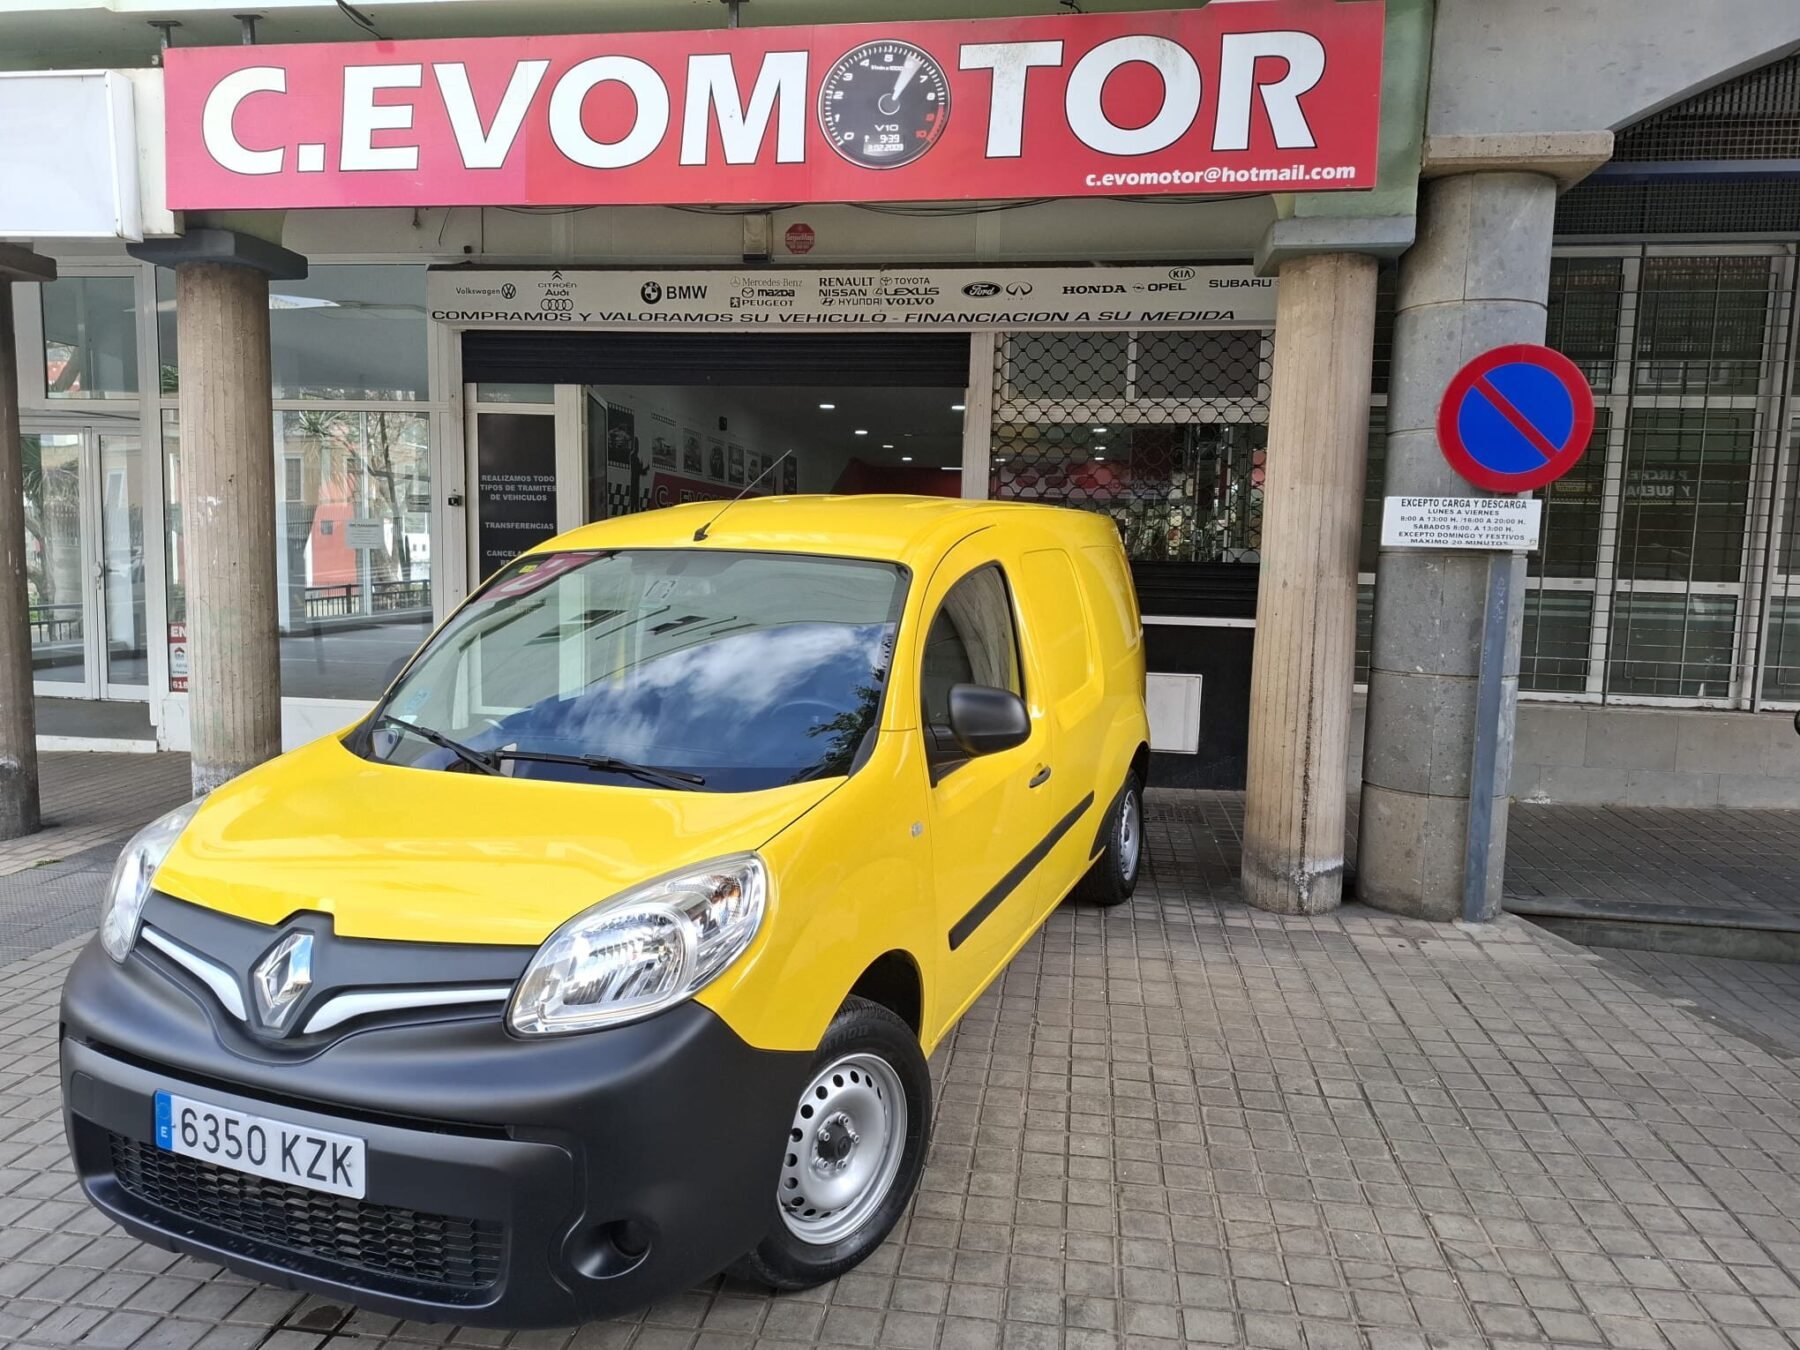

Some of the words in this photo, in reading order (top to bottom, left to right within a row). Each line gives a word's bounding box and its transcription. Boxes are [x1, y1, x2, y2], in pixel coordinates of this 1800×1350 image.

[842, 72, 854, 81] 3
[919, 75, 929, 83] 7
[833, 90, 845, 100] 2
[834, 113, 841, 122] 1
[874, 124, 899, 132] V10
[1085, 164, 1356, 187] c.evomotor@hotmail.com
[818, 276, 875, 287] RENAULT
[894, 277, 931, 285] TOYOTA
[1208, 279, 1272, 288] SUBARU
[455, 287, 501, 296] Volkswagen
[883, 287, 940, 296] LEXUS
[967, 282, 997, 297] Ford
[1061, 284, 1127, 295] HONDA
[1147, 282, 1187, 292] OPEL
[544, 288, 570, 297] Audi
[666, 285, 708, 300] BMW
[818, 288, 868, 297] NISSAN
[741, 299, 794, 307] PEUGEOT
[838, 297, 882, 306] HYUNDAI
[886, 297, 935, 306] VOLVO
[431, 310, 572, 322] COMPRAMOS
[579, 312, 592, 322] Y
[599, 311, 734, 323] VALORAMOS
[739, 313, 770, 323] SU
[778, 313, 888, 323] VEHICULO
[903, 311, 1069, 323] FINANCIACION
[1074, 311, 1091, 322] A
[1097, 310, 1132, 321] SU
[1139, 310, 1236, 321] MEDIDA
[502, 494, 548, 502] VEHICULOS
[1401, 498, 1440, 508] EXCEPTO
[1442, 499, 1471, 509] CARGA
[1473, 500, 1480, 509] Y
[1481, 500, 1528, 509] DESCARGA
[484, 521, 555, 530] TRANSFERENCIAS
[1413, 523, 1451, 531] SABADOS
[1485, 533, 1525, 541] FESTIVOS
[160, 1125, 169, 1139] E
[180, 1106, 267, 1166] 6350
[280, 1130, 354, 1188] KZK
